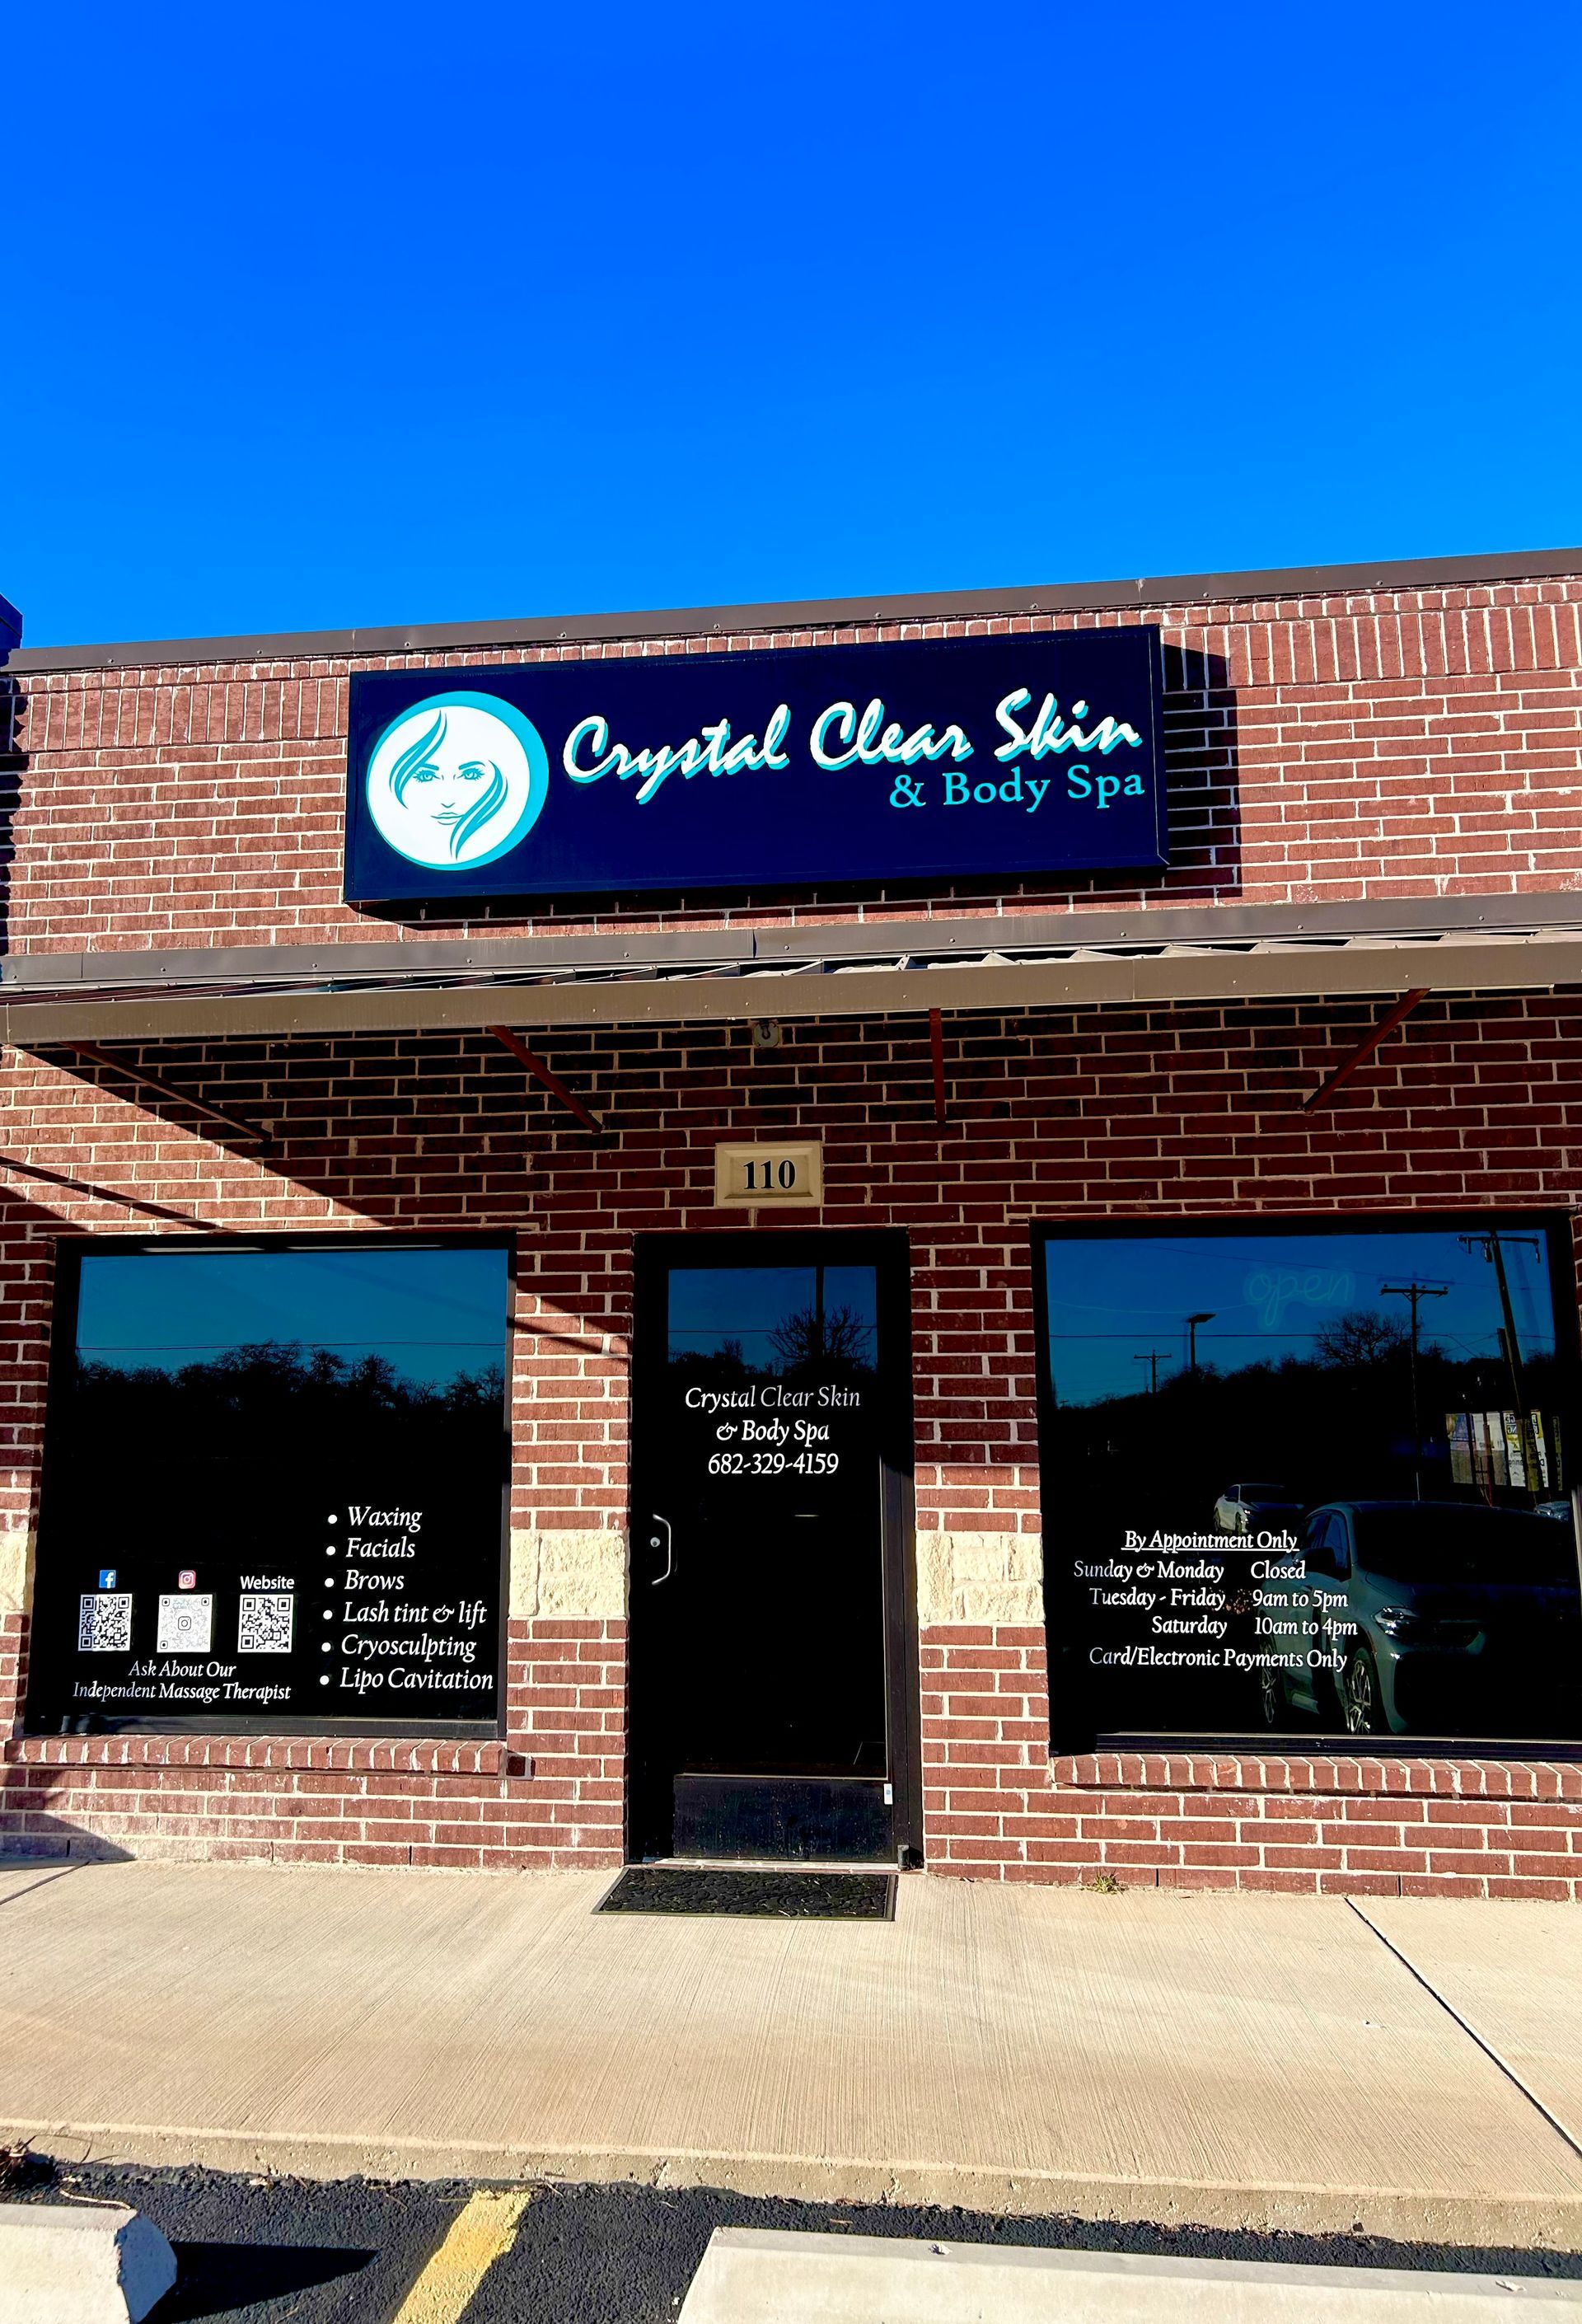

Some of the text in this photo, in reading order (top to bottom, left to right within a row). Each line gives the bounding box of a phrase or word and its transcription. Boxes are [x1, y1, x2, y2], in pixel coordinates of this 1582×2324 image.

[563, 688, 1142, 804] Crystal Clear Skin
[890, 765, 1144, 813] & Body Spa
[743, 1160, 795, 1189] 110
[1247, 1272, 1352, 1326] open
[686, 1385, 860, 1413] Crystal Clear Skin
[717, 1419, 829, 1447] & Body Spa
[709, 1453, 839, 1474] 682-329-4159
[349, 1506, 422, 1533] Waxing
[346, 1537, 415, 1558] Facials
[1125, 1530, 1299, 1553] By Appointment Only
[241, 1575, 294, 1589] Website
[344, 1570, 404, 1590] Brows
[1074, 1559, 1306, 1583] Sunday & Monday Closed
[1089, 1587, 1156, 1610] Tuesday
[1171, 1587, 1225, 1610] Friday
[1252, 1589, 1289, 1606] 9am
[1292, 1592, 1309, 1608] to
[1312, 1590, 1348, 1613] 5pm
[343, 1600, 487, 1630] Lash tint & lift
[1152, 1615, 1358, 1641] Saturday 10am to 4pm
[342, 1633, 476, 1663] Cryosculpting
[1090, 1647, 1347, 1672] Card/Electronic Payments Only
[129, 1660, 236, 1677] Ask About Our
[340, 1667, 493, 1694] Lipo Cavitation
[73, 1681, 291, 1704] Independent Massage Therapist
